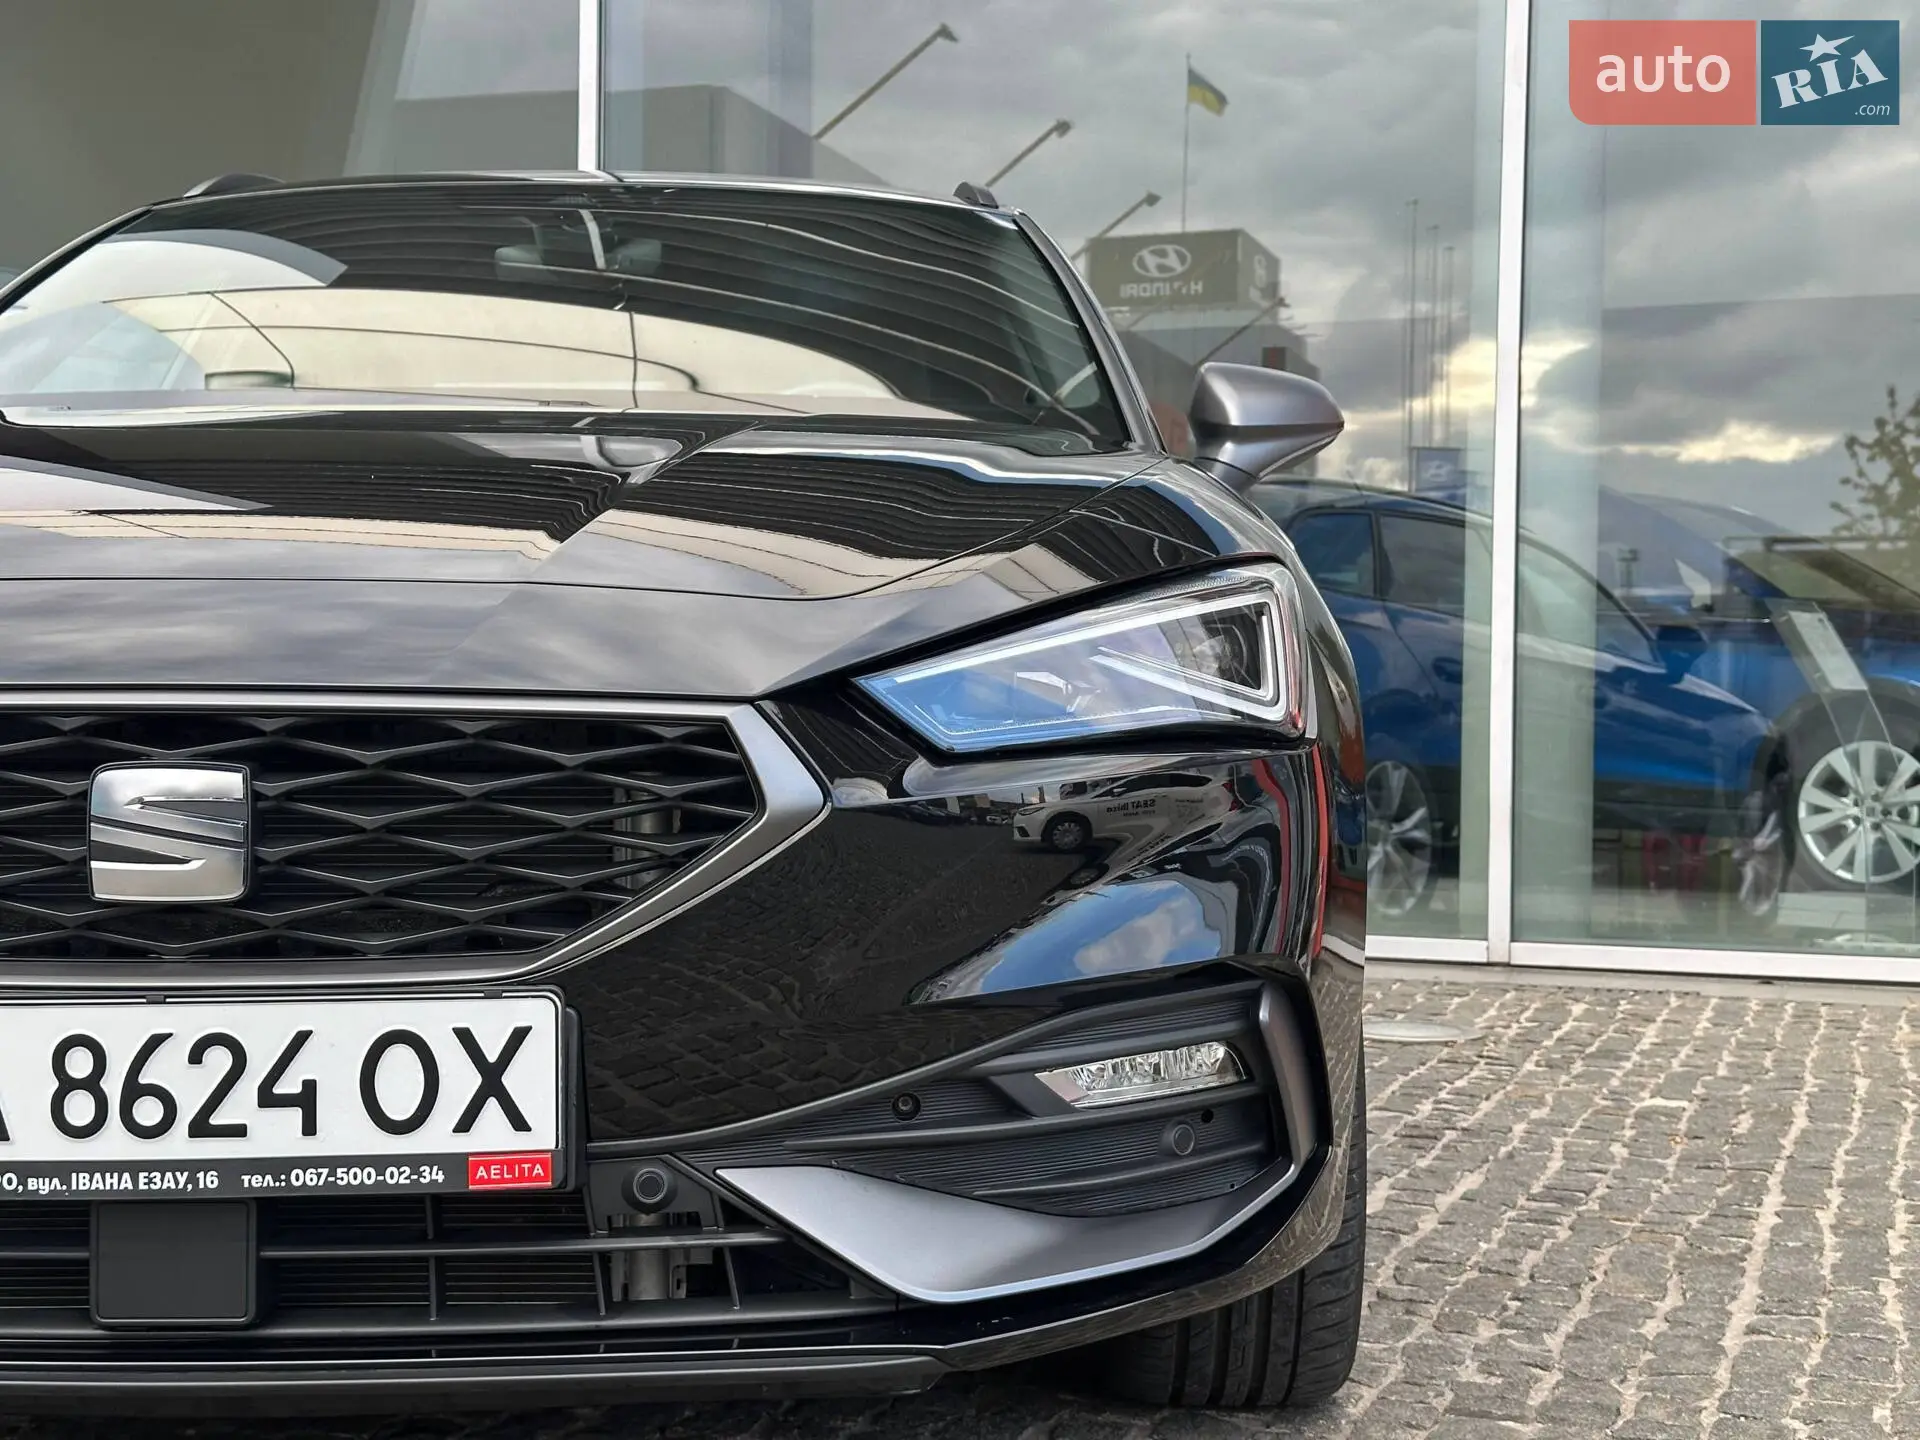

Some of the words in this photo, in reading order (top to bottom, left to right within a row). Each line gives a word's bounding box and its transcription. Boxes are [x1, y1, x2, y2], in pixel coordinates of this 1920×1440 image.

[50, 1029, 318, 1140] 8624
[359, 1025, 533, 1136] OX
[27, 1177, 68, 1195] вул.
[71, 1172, 134, 1191] ІВАНА
[138, 1171, 193, 1192] ЕЗАУ,
[197, 1170, 219, 1189] 16
[240, 1174, 286, 1188] тел.:
[290, 1165, 445, 1187] 067-500-02-34
[475, 1163, 545, 1179] AELITA
